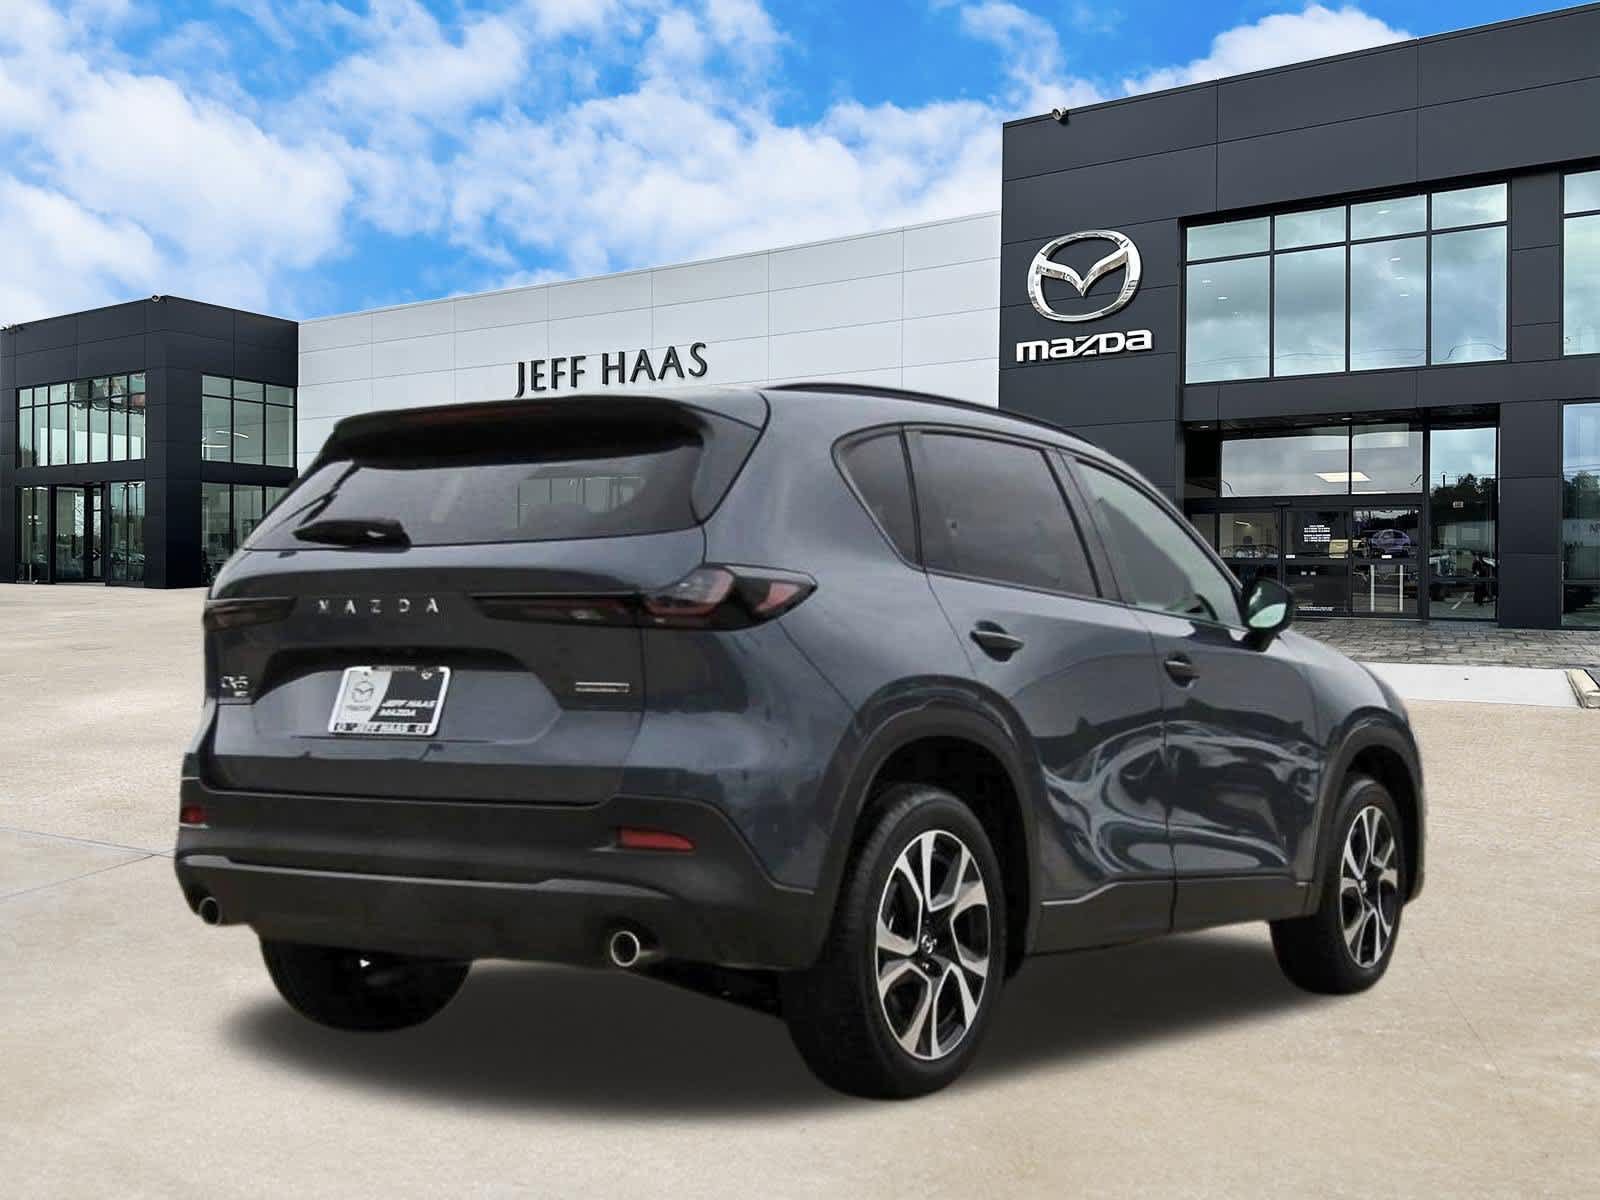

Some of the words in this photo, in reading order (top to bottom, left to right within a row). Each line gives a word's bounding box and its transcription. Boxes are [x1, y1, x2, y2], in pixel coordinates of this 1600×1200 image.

[1016, 329, 1152, 362] mazda
[514, 355, 586, 398] JEFF
[602, 342, 708, 385] HAAS
[318, 597, 440, 614] MAZDA
